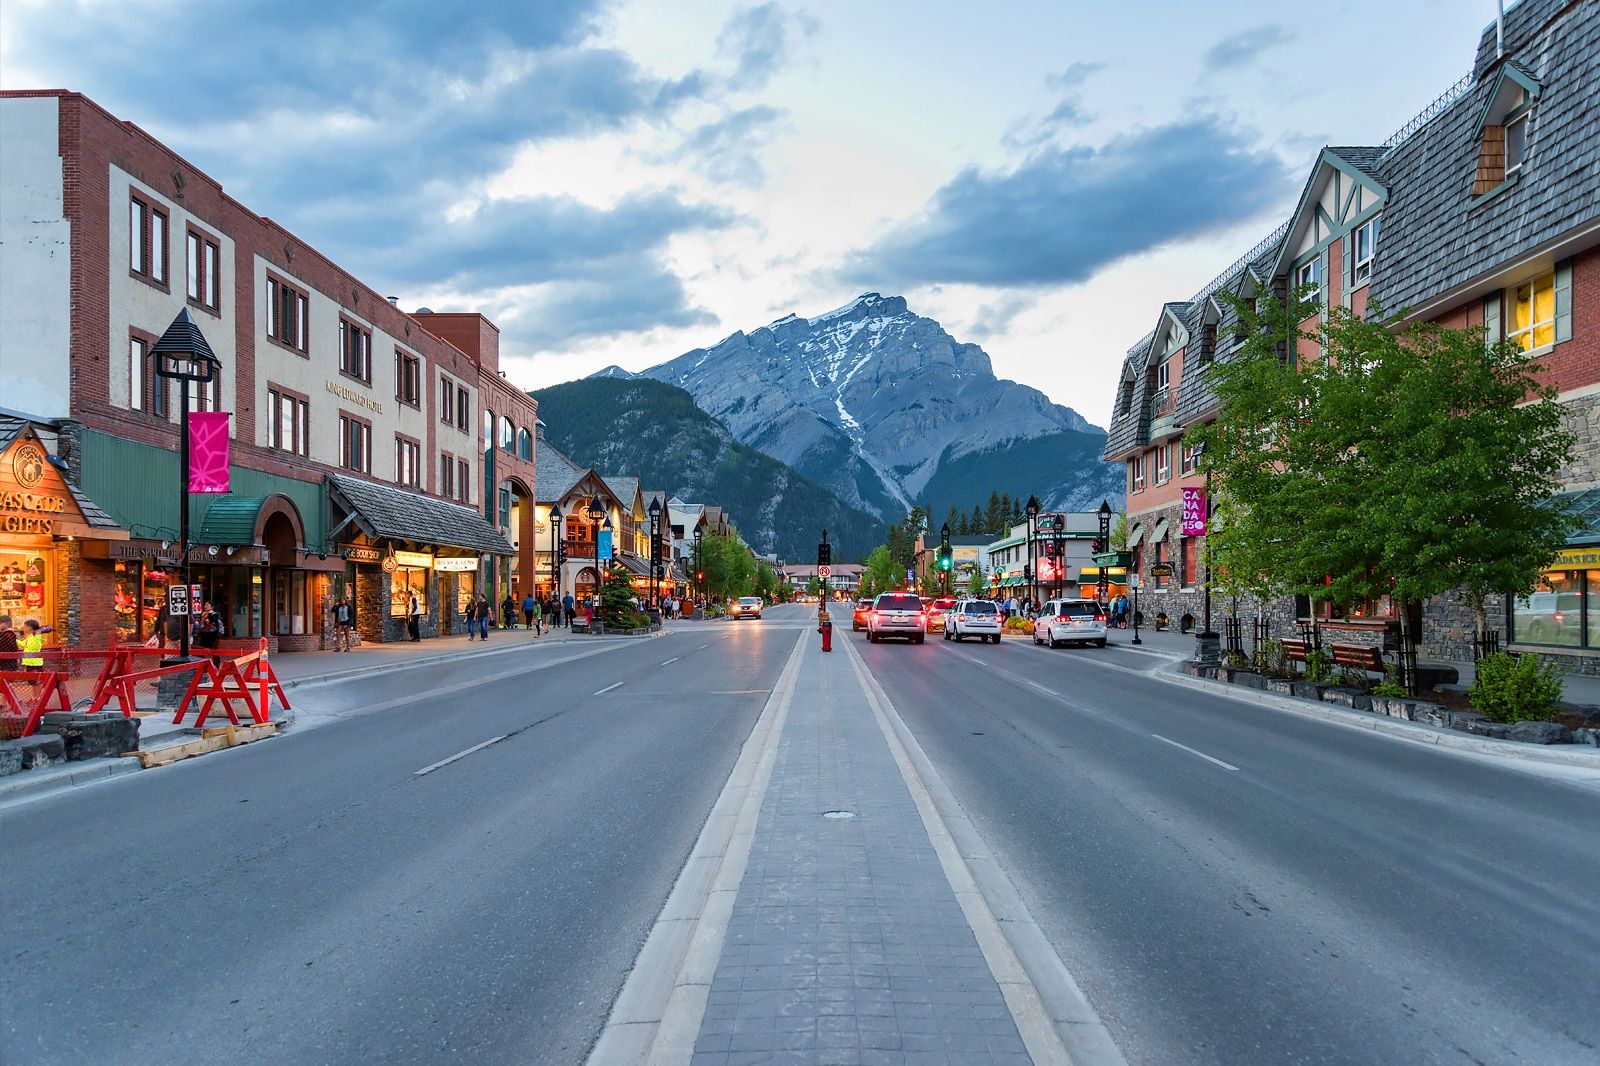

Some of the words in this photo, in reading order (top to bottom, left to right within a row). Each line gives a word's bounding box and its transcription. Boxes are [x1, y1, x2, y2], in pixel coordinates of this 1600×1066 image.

[1183, 491, 1199, 500] CA
[1183, 500, 1199, 510] NA
[1183, 510, 1199, 520] DA
[6, 516, 53, 534] GIFTS
[121, 544, 138, 557] THE
[166, 549, 178, 560] OF
[1582, 554, 1597, 563] ICE
